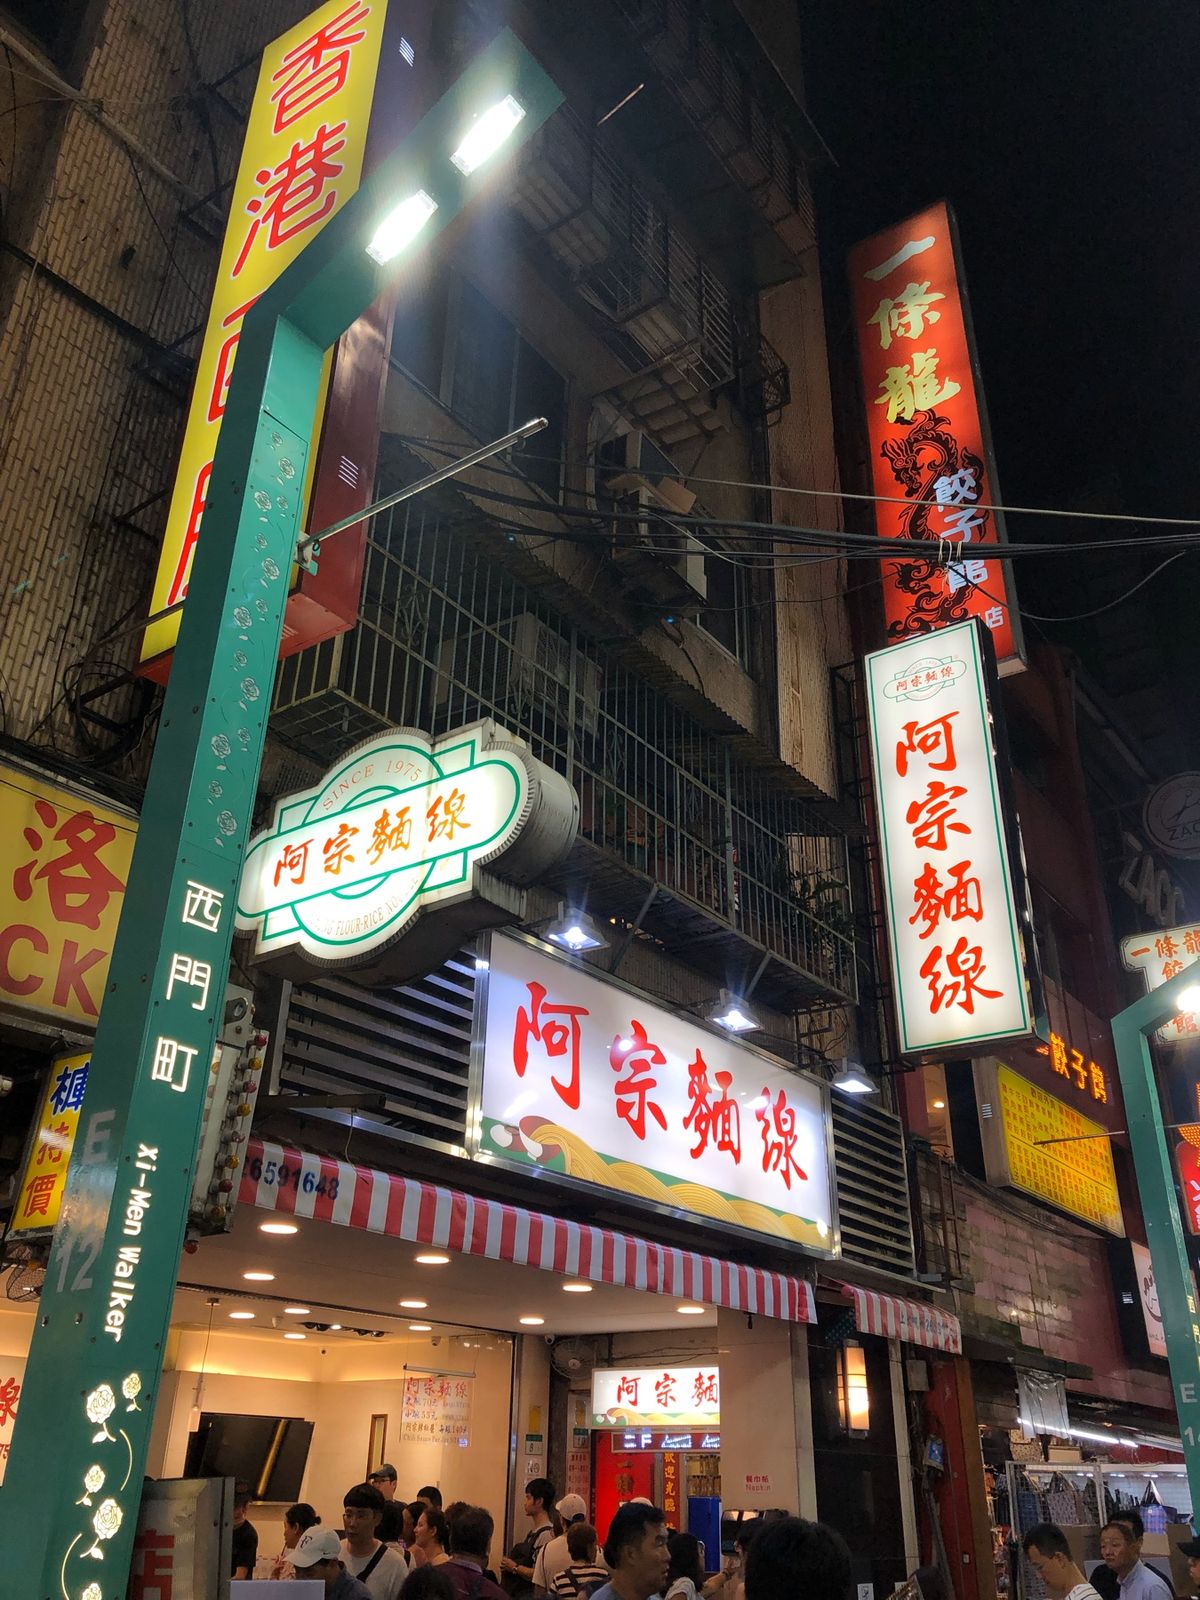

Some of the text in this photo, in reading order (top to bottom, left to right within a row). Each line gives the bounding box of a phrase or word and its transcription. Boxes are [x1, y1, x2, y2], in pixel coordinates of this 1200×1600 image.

[864, 234, 961, 424] 一條龍
[896, 665, 955, 692] 阿宗麵線
[322, 760, 424, 811] SINCE 1975
[14, 800, 125, 931] 洛
[273, 788, 471, 888] 阿宗麵線
[895, 710, 1004, 1016] 阿宗麵線
[151, 880, 224, 1092] 西門町
[513, 981, 808, 1190] 阿宗麵線
[82, 1109, 116, 1165] E
[122, 1143, 159, 1237] Xi-Men
[55, 1238, 99, 1293] 12
[1180, 1383, 1197, 1403] E
